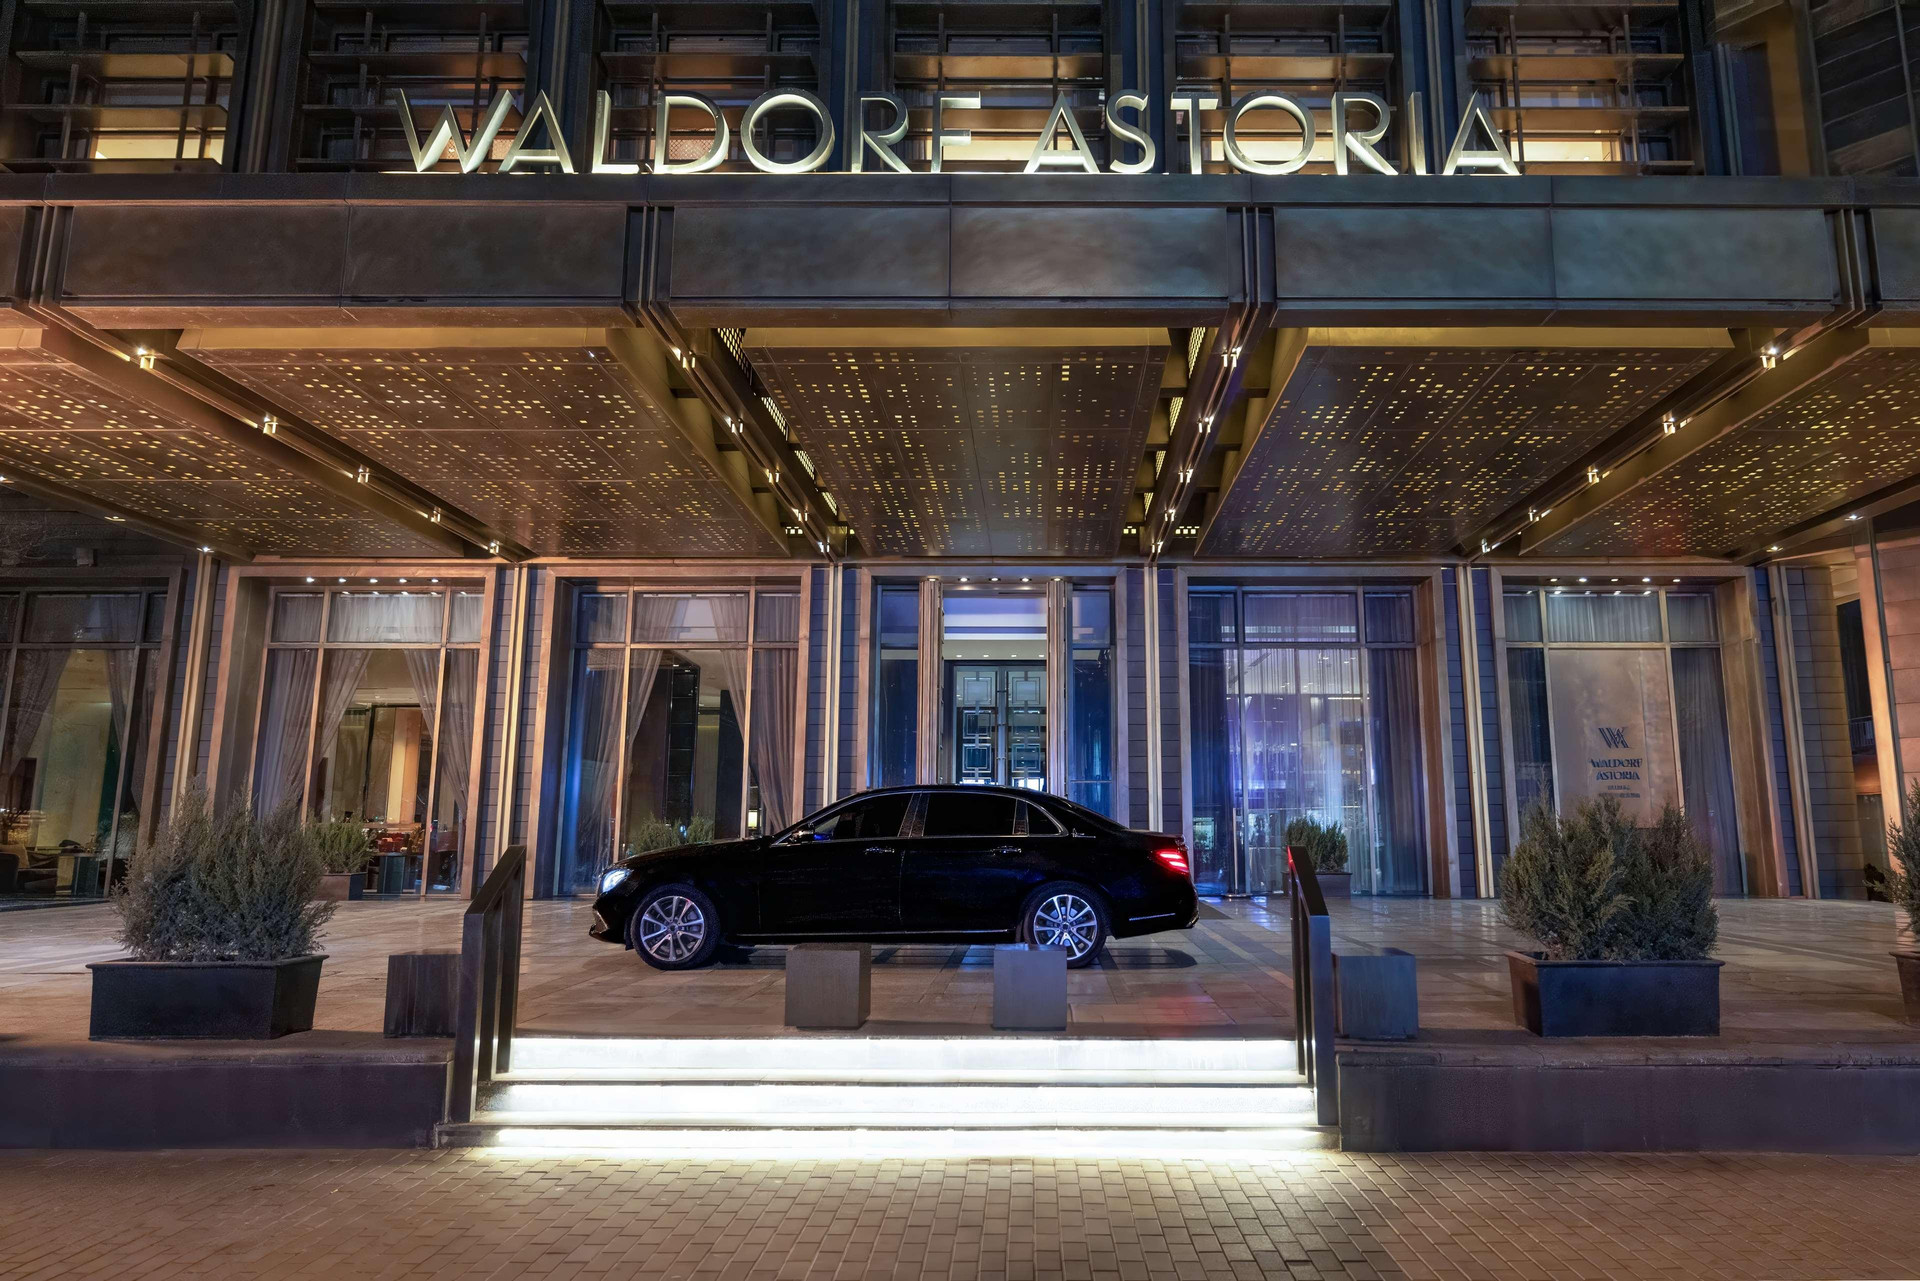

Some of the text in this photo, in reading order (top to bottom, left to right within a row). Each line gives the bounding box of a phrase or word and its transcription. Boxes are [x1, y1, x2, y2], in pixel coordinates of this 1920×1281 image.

[398, 88, 1522, 175] WALDORF ASTORIA
[1589, 758, 1643, 768] WALDORF
[1596, 771, 1640, 780] ASTORIA
